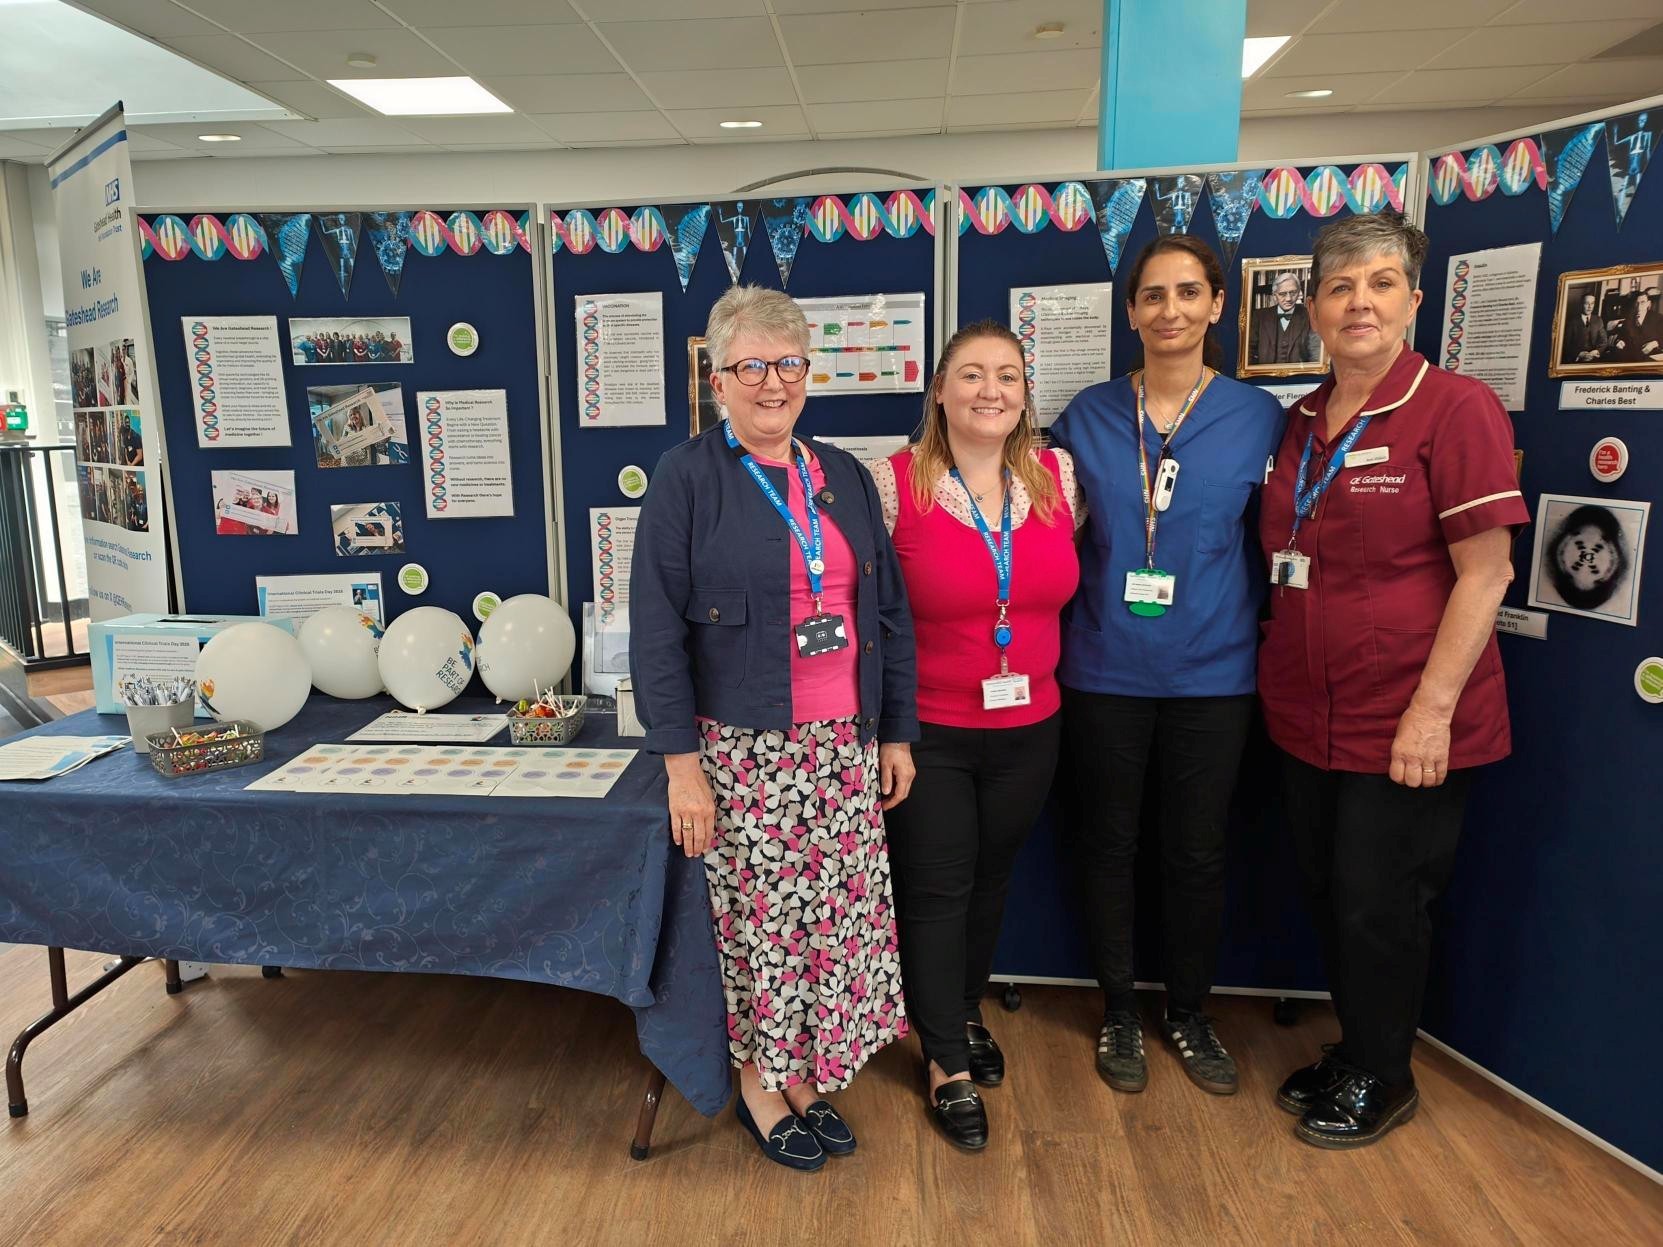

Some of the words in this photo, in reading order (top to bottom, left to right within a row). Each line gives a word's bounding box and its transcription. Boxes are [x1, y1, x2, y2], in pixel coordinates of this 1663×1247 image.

[106, 179, 120, 206] NHS
[81, 270, 91, 290] We
[92, 266, 101, 286] Are
[97, 292, 119, 320] Research
[1188, 388, 1199, 403] NHS
[1574, 385, 1611, 394] Frederick
[1612, 385, 1643, 395] Banting
[1644, 385, 1651, 393] &
[1585, 397, 1617, 405] Charles
[1617, 397, 1637, 405] Best
[1341, 419, 1366, 452] RESEARCH
[747, 461, 770, 491] RESEARCH
[767, 489, 782, 507] TEAM
[1323, 466, 1336, 484] TEAM
[1362, 474, 1407, 484] Gateshead
[1379, 486, 1400, 494] Nurse
[789, 519, 808, 552] RESEARCH
[814, 537, 822, 560] EARCH
[983, 531, 1000, 562] RESEARCH
[1504, 611, 1529, 621] Franklin
[446, 656, 459, 668] BE
[435, 669, 462, 695] RESEARC
[442, 664, 460, 681] PART
